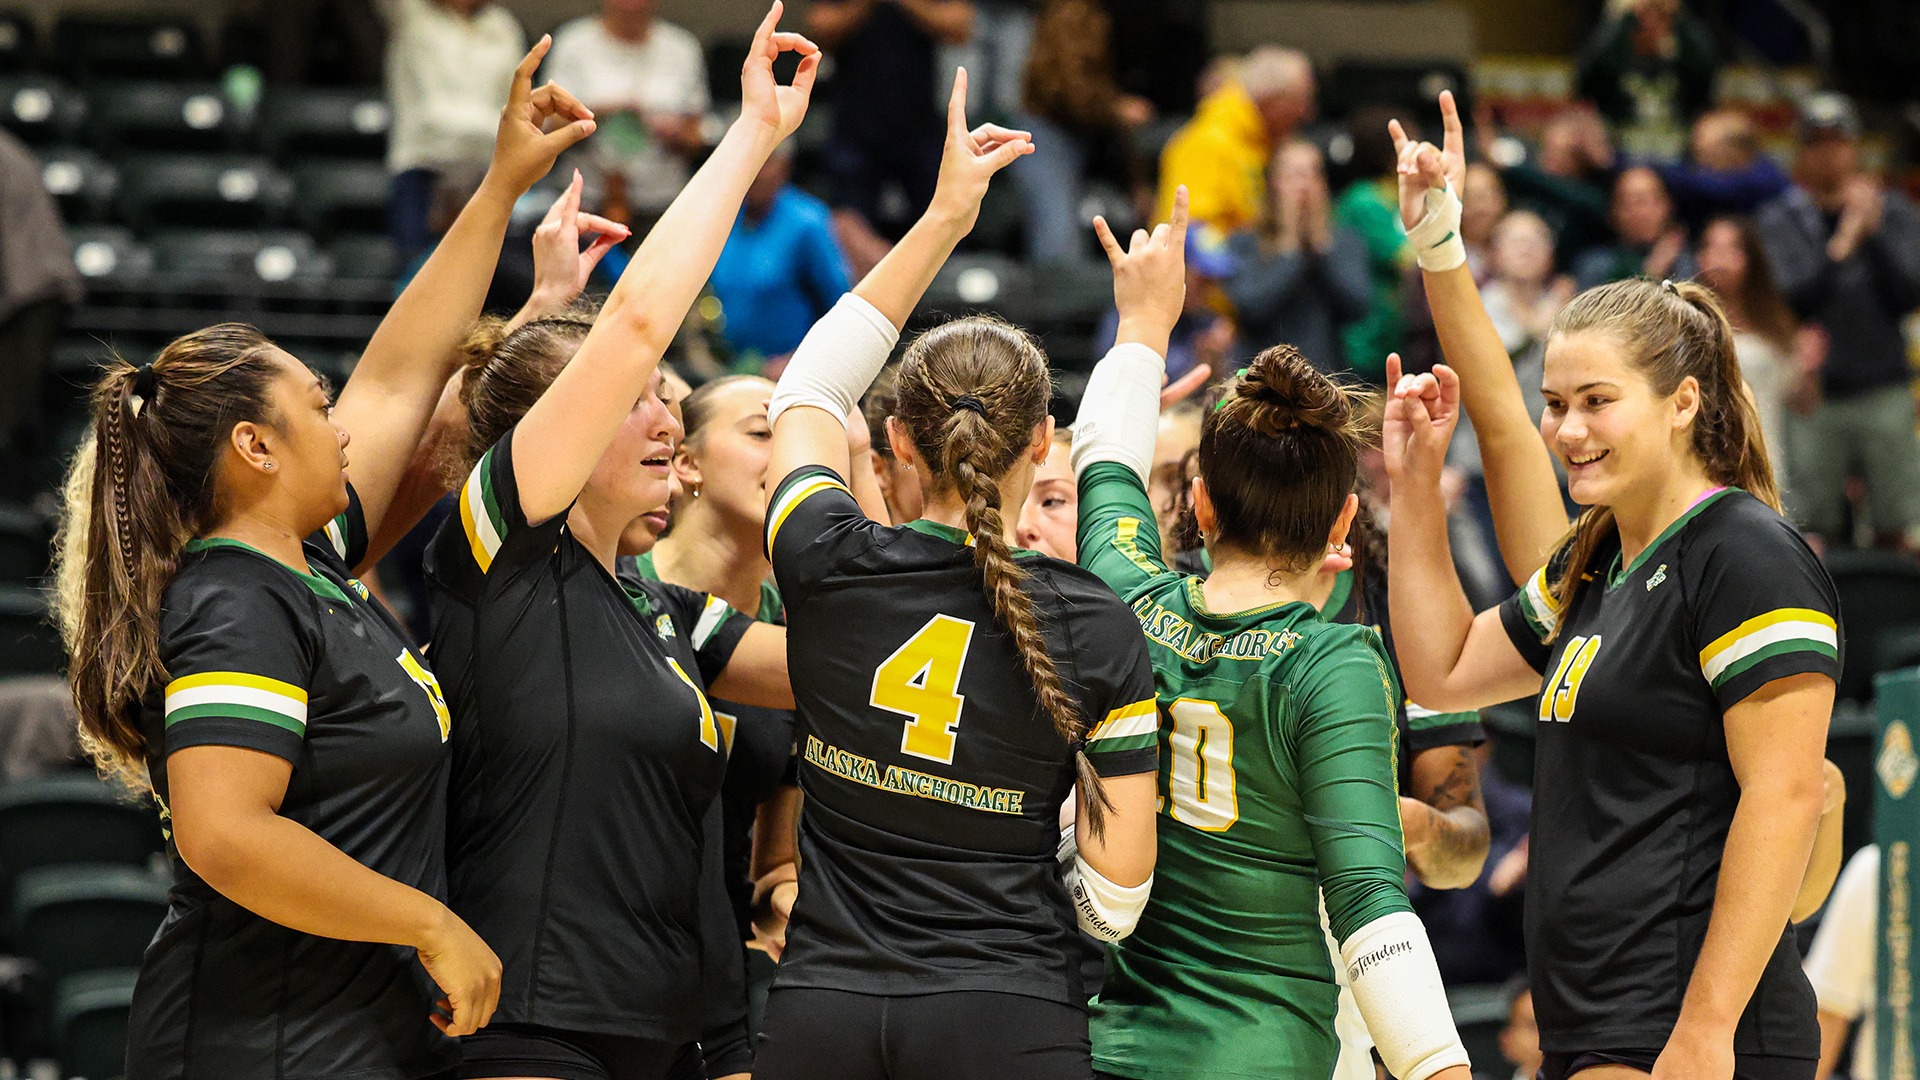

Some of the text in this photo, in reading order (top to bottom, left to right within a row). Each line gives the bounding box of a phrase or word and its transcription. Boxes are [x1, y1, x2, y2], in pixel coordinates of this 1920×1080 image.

[1131, 594, 1304, 665] LASKA NCHORG
[869, 612, 976, 766] 4
[1538, 634, 1603, 723] 19
[804, 734, 1026, 816] ALASKA ANCHORAGE
[1156, 697, 1240, 833] 0
[1077, 879, 1121, 939] Tandem
[1348, 940, 1413, 977] Tandem
